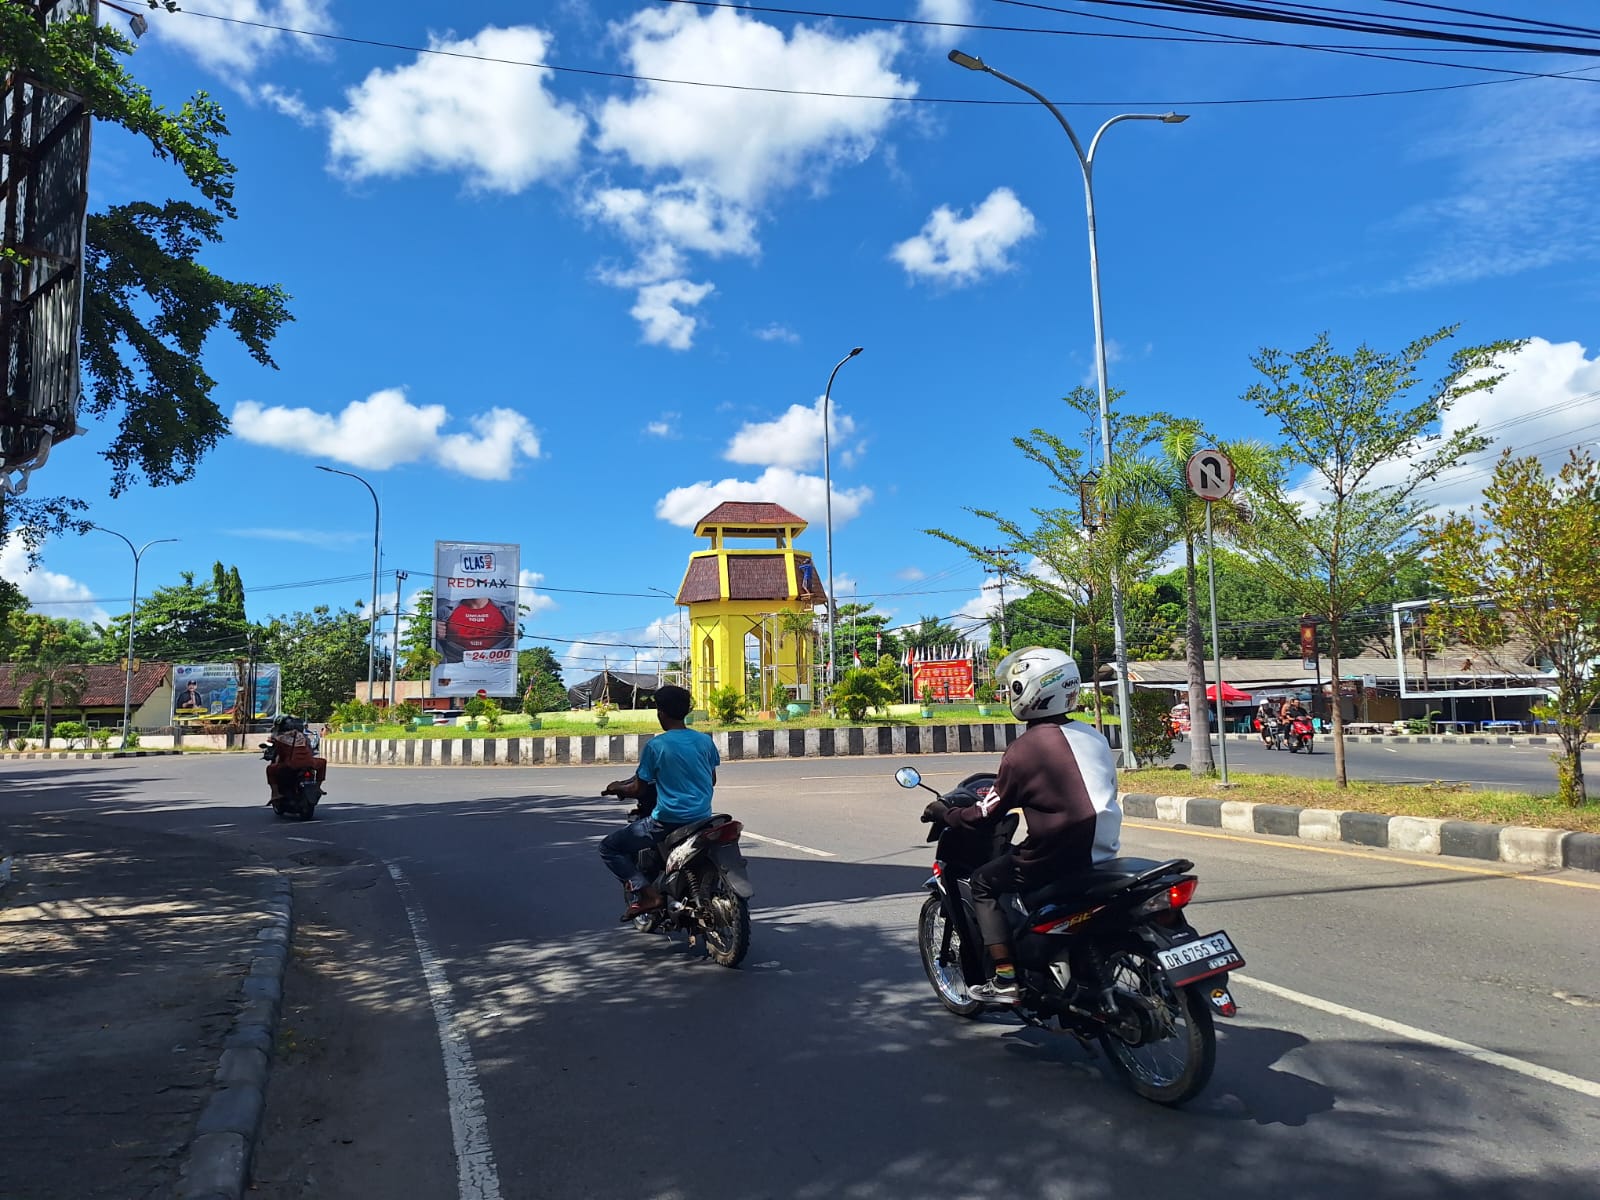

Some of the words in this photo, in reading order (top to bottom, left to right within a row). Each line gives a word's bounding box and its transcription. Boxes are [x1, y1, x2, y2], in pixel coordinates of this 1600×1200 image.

[463, 555, 485, 570] CLAS
[447, 577, 507, 588] REDMAX
[472, 650, 510, 660] 24.000
[1165, 953, 1184, 968] DR
[1181, 943, 1210, 961] 6755
[1210, 938, 1226, 953] EP
